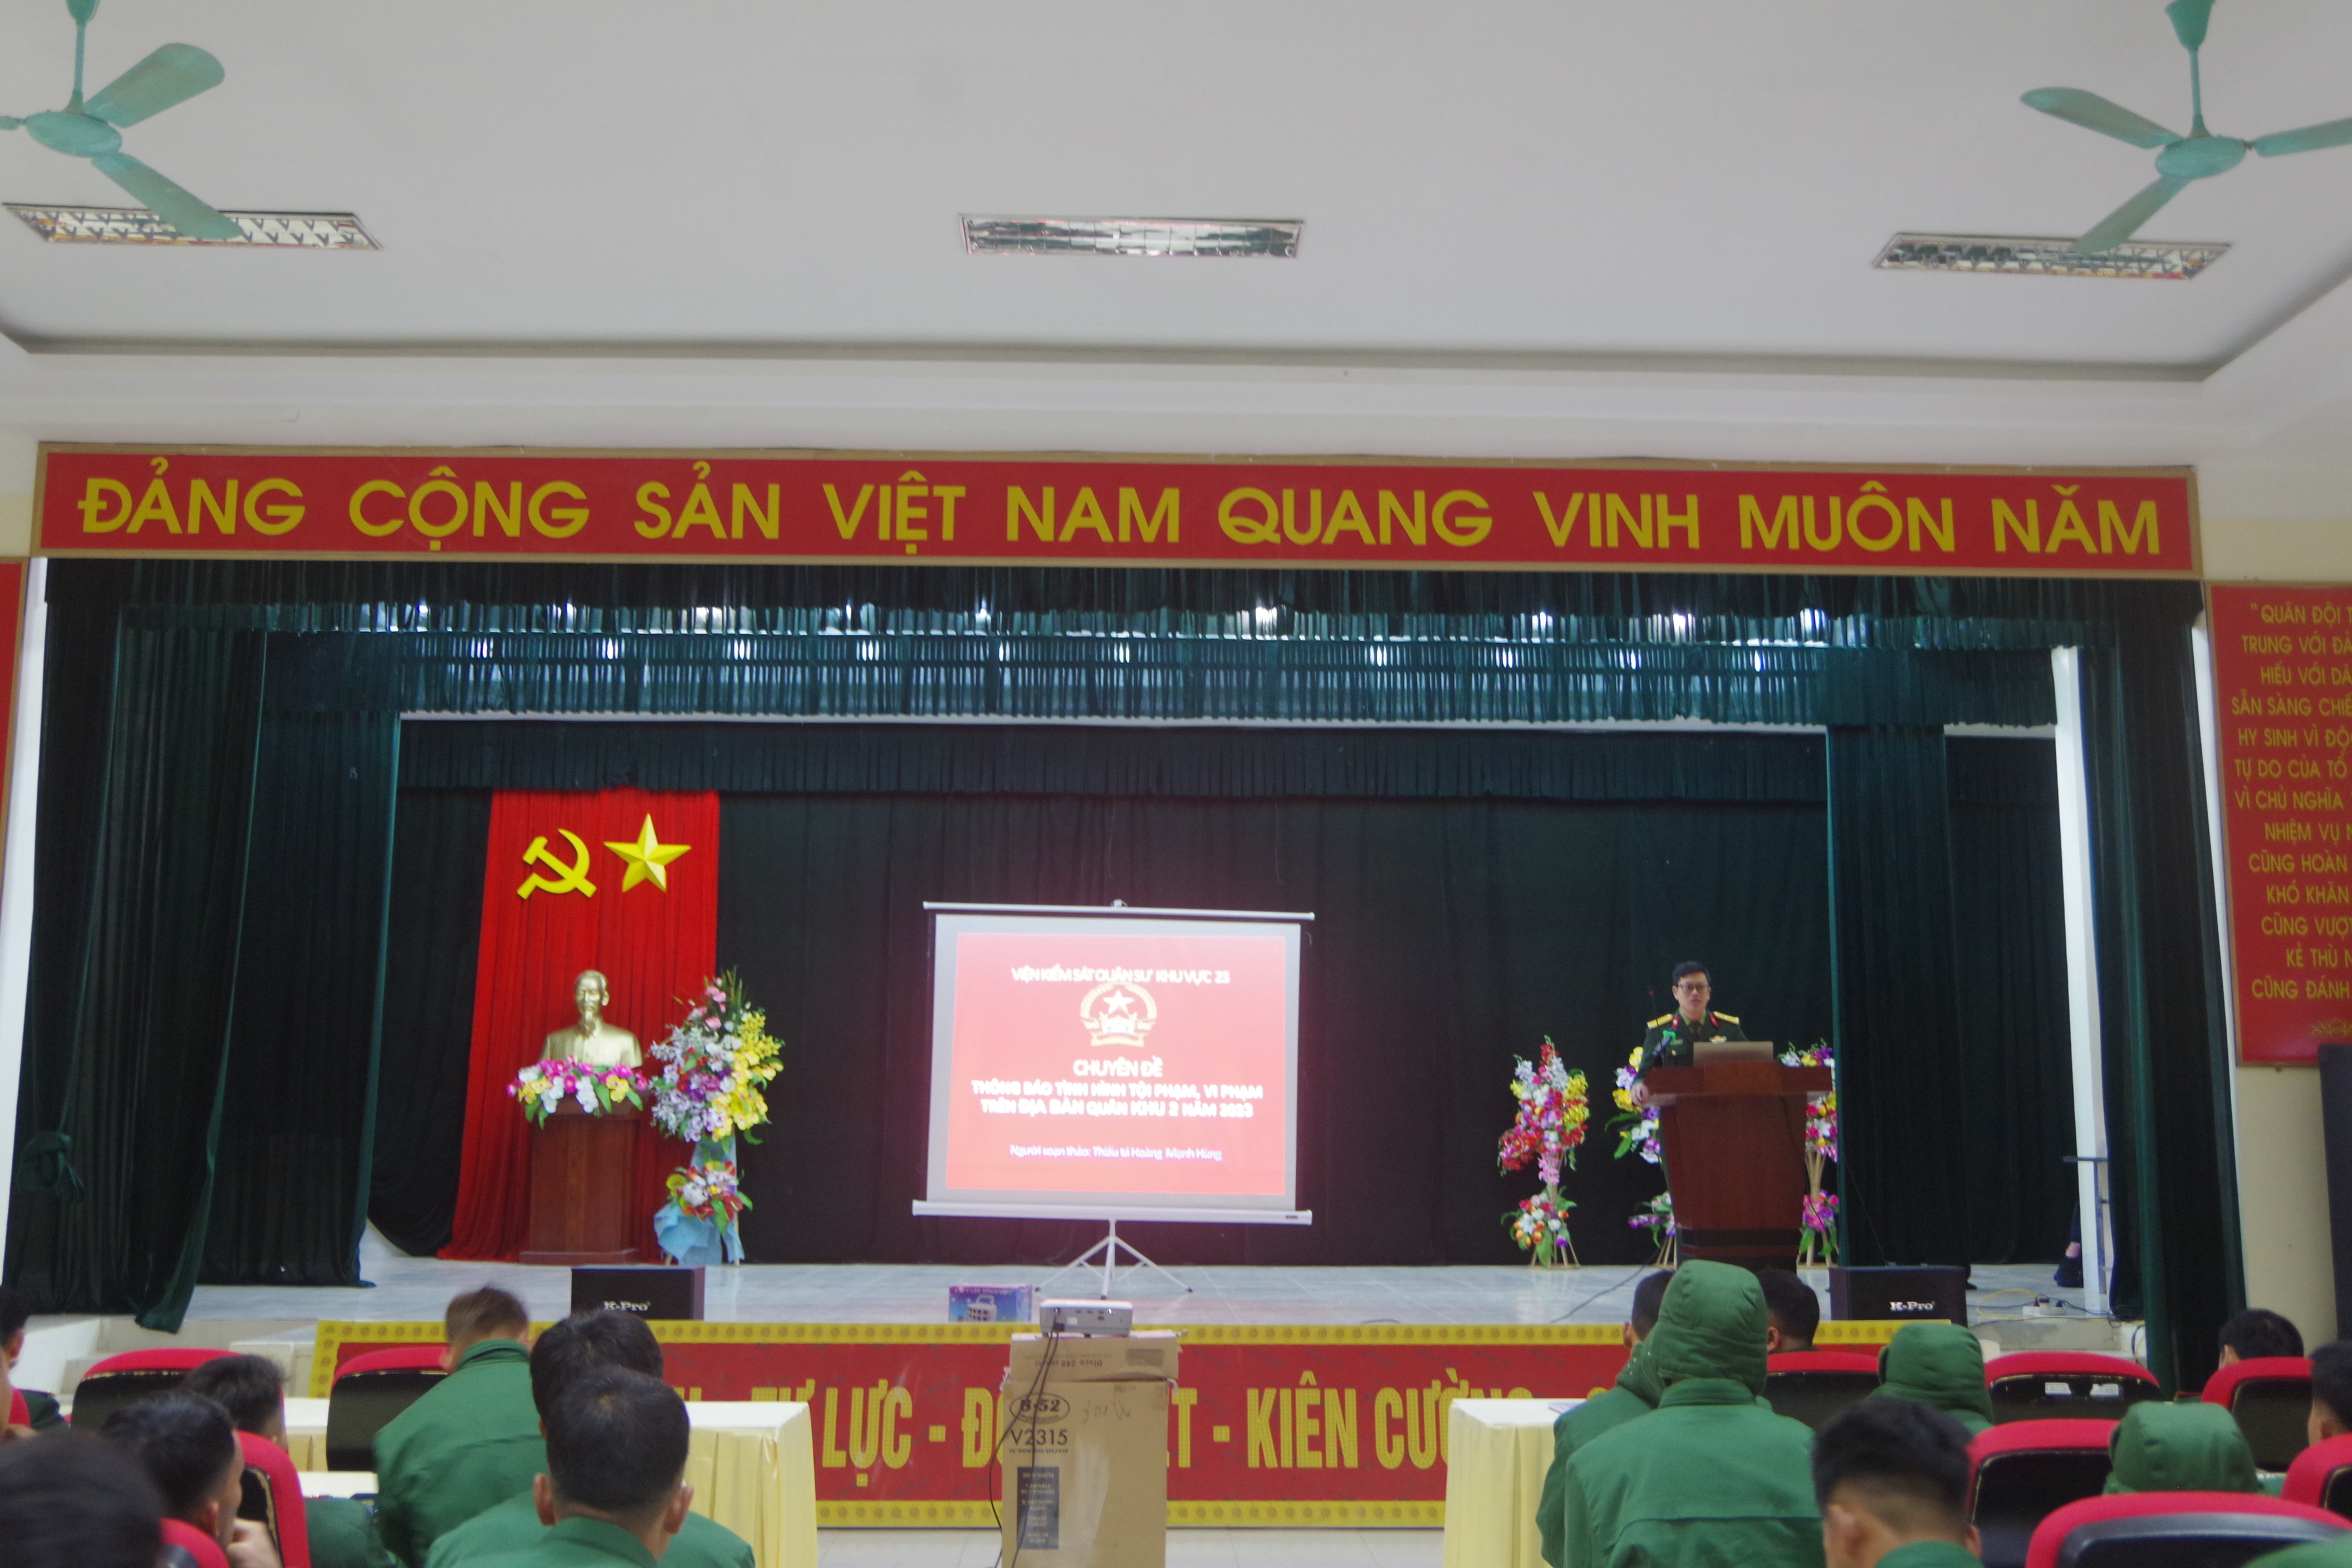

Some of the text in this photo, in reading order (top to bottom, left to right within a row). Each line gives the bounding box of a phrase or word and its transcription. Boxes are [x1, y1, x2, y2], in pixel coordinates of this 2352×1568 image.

[77, 456, 2160, 555] ĐẢNG CỘNG SẢN VIỆT NAM QUANG VINH MUÔN NĂM
[2311, 601, 2341, 628] ĐỘI
[2241, 635, 2292, 654] TRUNG
[2298, 630, 2326, 655] VỚI
[2261, 661, 2292, 685] HIẾU
[2297, 661, 2326, 686] VỚI
[2267, 692, 2312, 717] SÀNG
[2238, 727, 2258, 746] HY
[2264, 727, 2298, 747] SINH
[2304, 724, 2319, 747] VÌ
[2258, 758, 2282, 778] DO
[2288, 753, 2321, 779] CỦA
[2235, 785, 2344, 810] VÌ CHỦ NGHĨA
[2265, 819, 2311, 845] NHIỆM
[2319, 823, 2340, 846] VỤ
[2249, 849, 2348, 874] CŨNG HOÀN
[2266, 879, 2350, 904] KHÓ KHĂN
[2261, 912, 2308, 936] CŨNG
[2286, 942, 2304, 968] KẺ
[2310, 943, 2338, 968] THÙ
[1155, 969, 1183, 983] KHU
[2252, 975, 2350, 999] CŨNG ĐÁNH
[1073, 1056, 1139, 1077] CHUYÊN
[1203, 1084, 1218, 1099] VI
[1130, 1100, 1166, 1116] KHU
[1168, 1101, 1179, 1116] 2
[603, 1301, 648, 1311] K-Pro
[1889, 1301, 1933, 1311] K-Pro
[1247, 1370, 1358, 1468] KIÊN
[822, 1379, 912, 1487] LỰC
[1011, 1429, 1068, 1445] V2315
